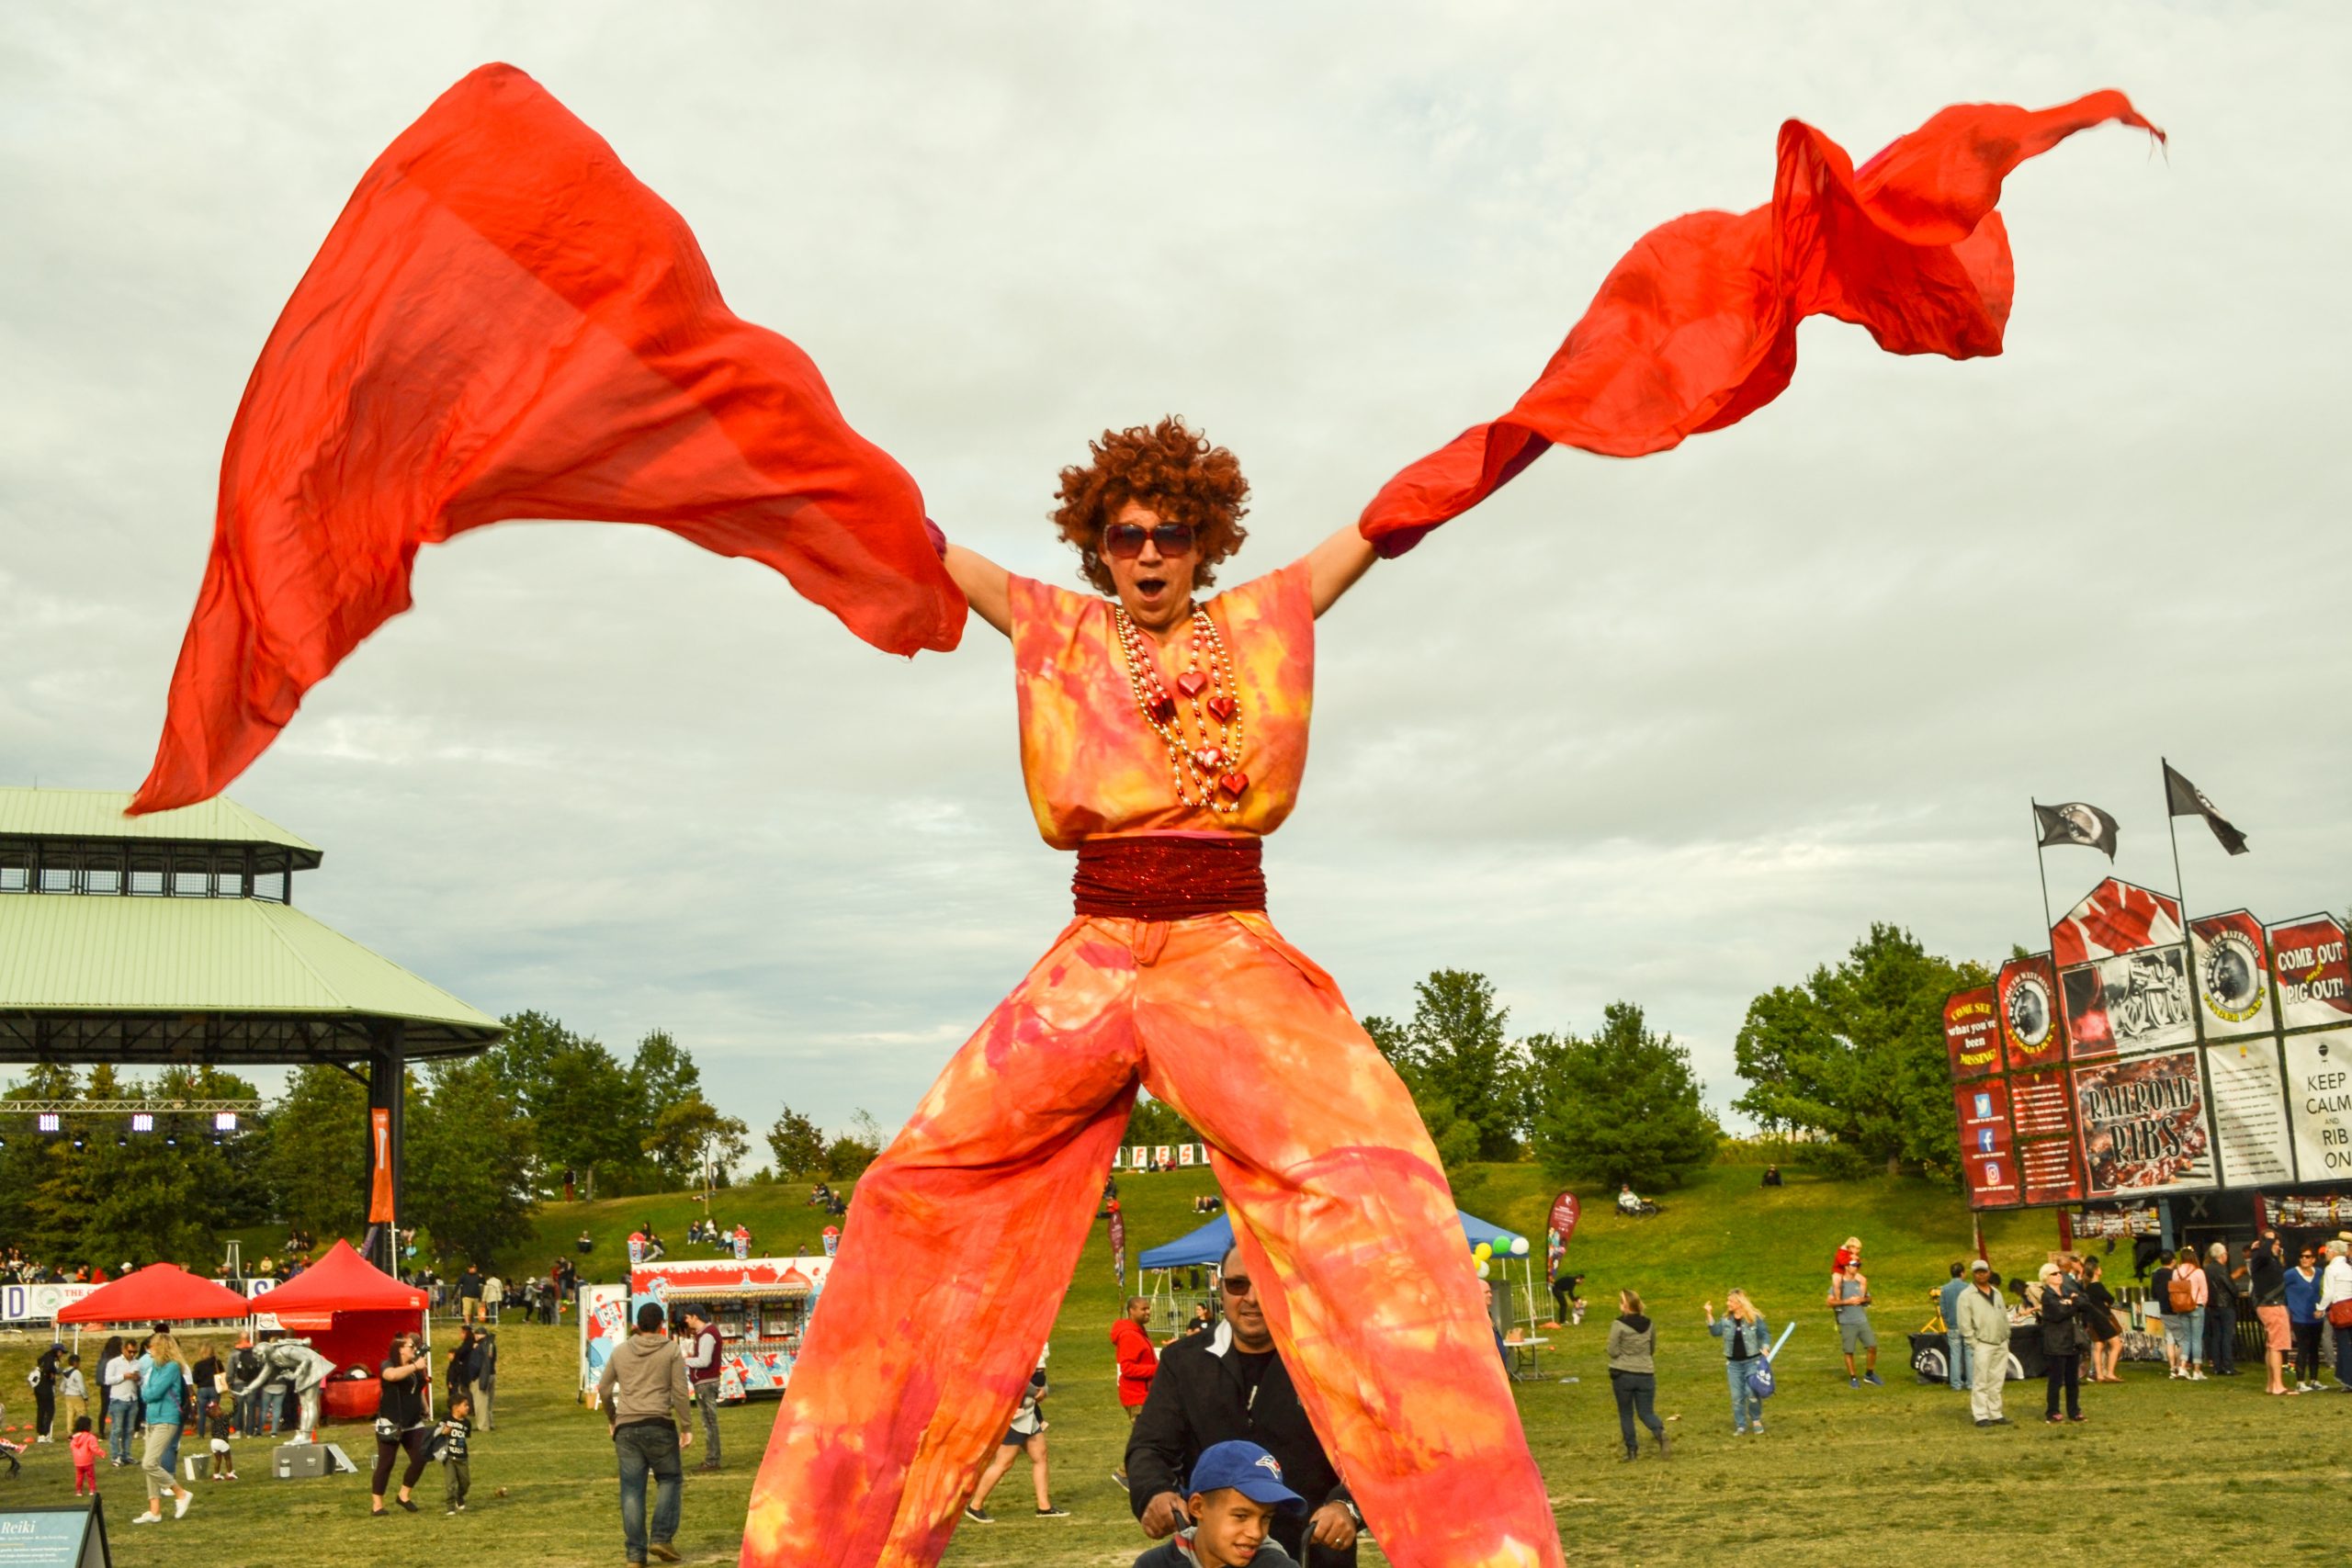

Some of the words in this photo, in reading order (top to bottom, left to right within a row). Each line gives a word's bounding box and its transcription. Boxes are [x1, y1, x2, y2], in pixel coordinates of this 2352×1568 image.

[2222, 931, 2261, 958] WATERING
[2278, 946, 2315, 971] COME
[2317, 942, 2344, 964] OUT
[2287, 982, 2309, 1005] PIG
[2312, 977, 2344, 1000] OUT!
[1951, 1004, 1973, 1021] COME
[1974, 1002, 1992, 1015] SEE
[1948, 1024, 1970, 1036] what
[1971, 1019, 1996, 1034] you've
[1964, 1037, 1986, 1048] been
[2307, 1072, 2346, 1092] KEEP
[2088, 1076, 2194, 1121] RAILROAD
[2306, 1094, 2352, 1115] CALM
[2324, 1117, 2340, 1125] AND
[2109, 1116, 2183, 1167] RIBS
[2322, 1128, 2349, 1145] RIB
[2324, 1151, 2352, 1168] ON
[8, 1286, 25, 1317] D
[63, 1289, 84, 1297] THE
[1, 1519, 36, 1534] Reiki
